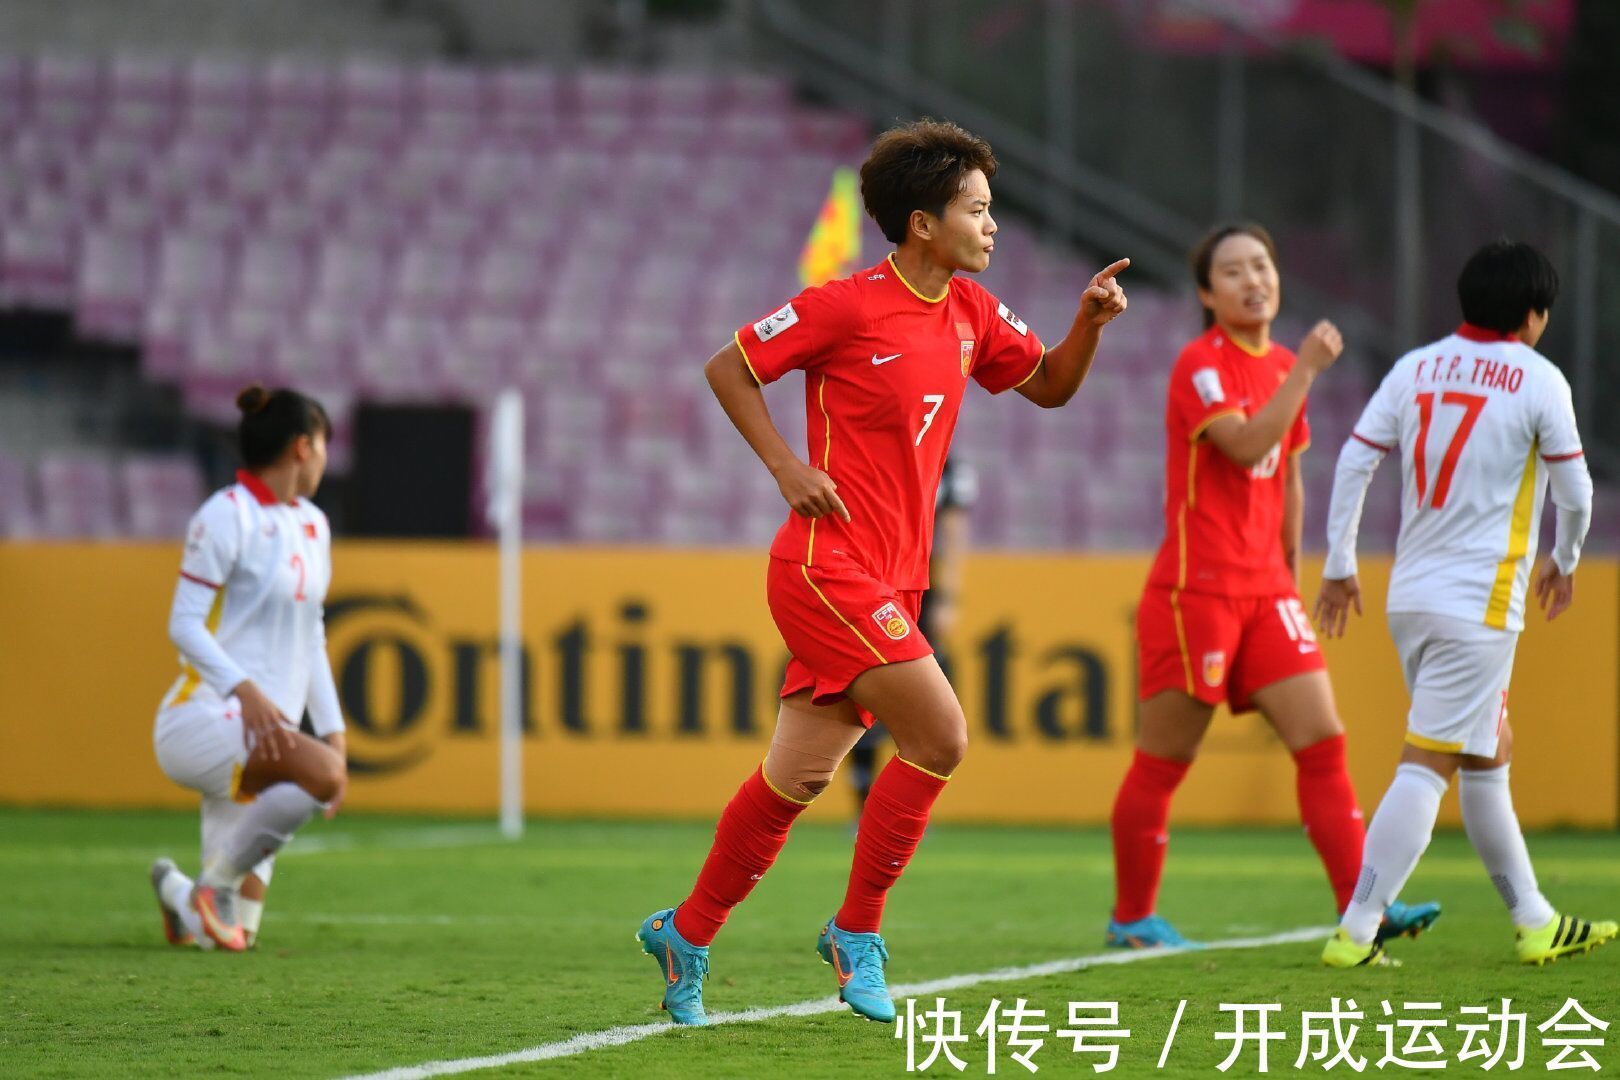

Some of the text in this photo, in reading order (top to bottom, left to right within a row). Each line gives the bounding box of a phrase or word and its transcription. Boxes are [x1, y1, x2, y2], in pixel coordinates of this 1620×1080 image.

[1471, 358, 1524, 394] THAO
[914, 394, 945, 447] 7
[1414, 391, 1489, 510] 17
[289, 553, 306, 602] 2
